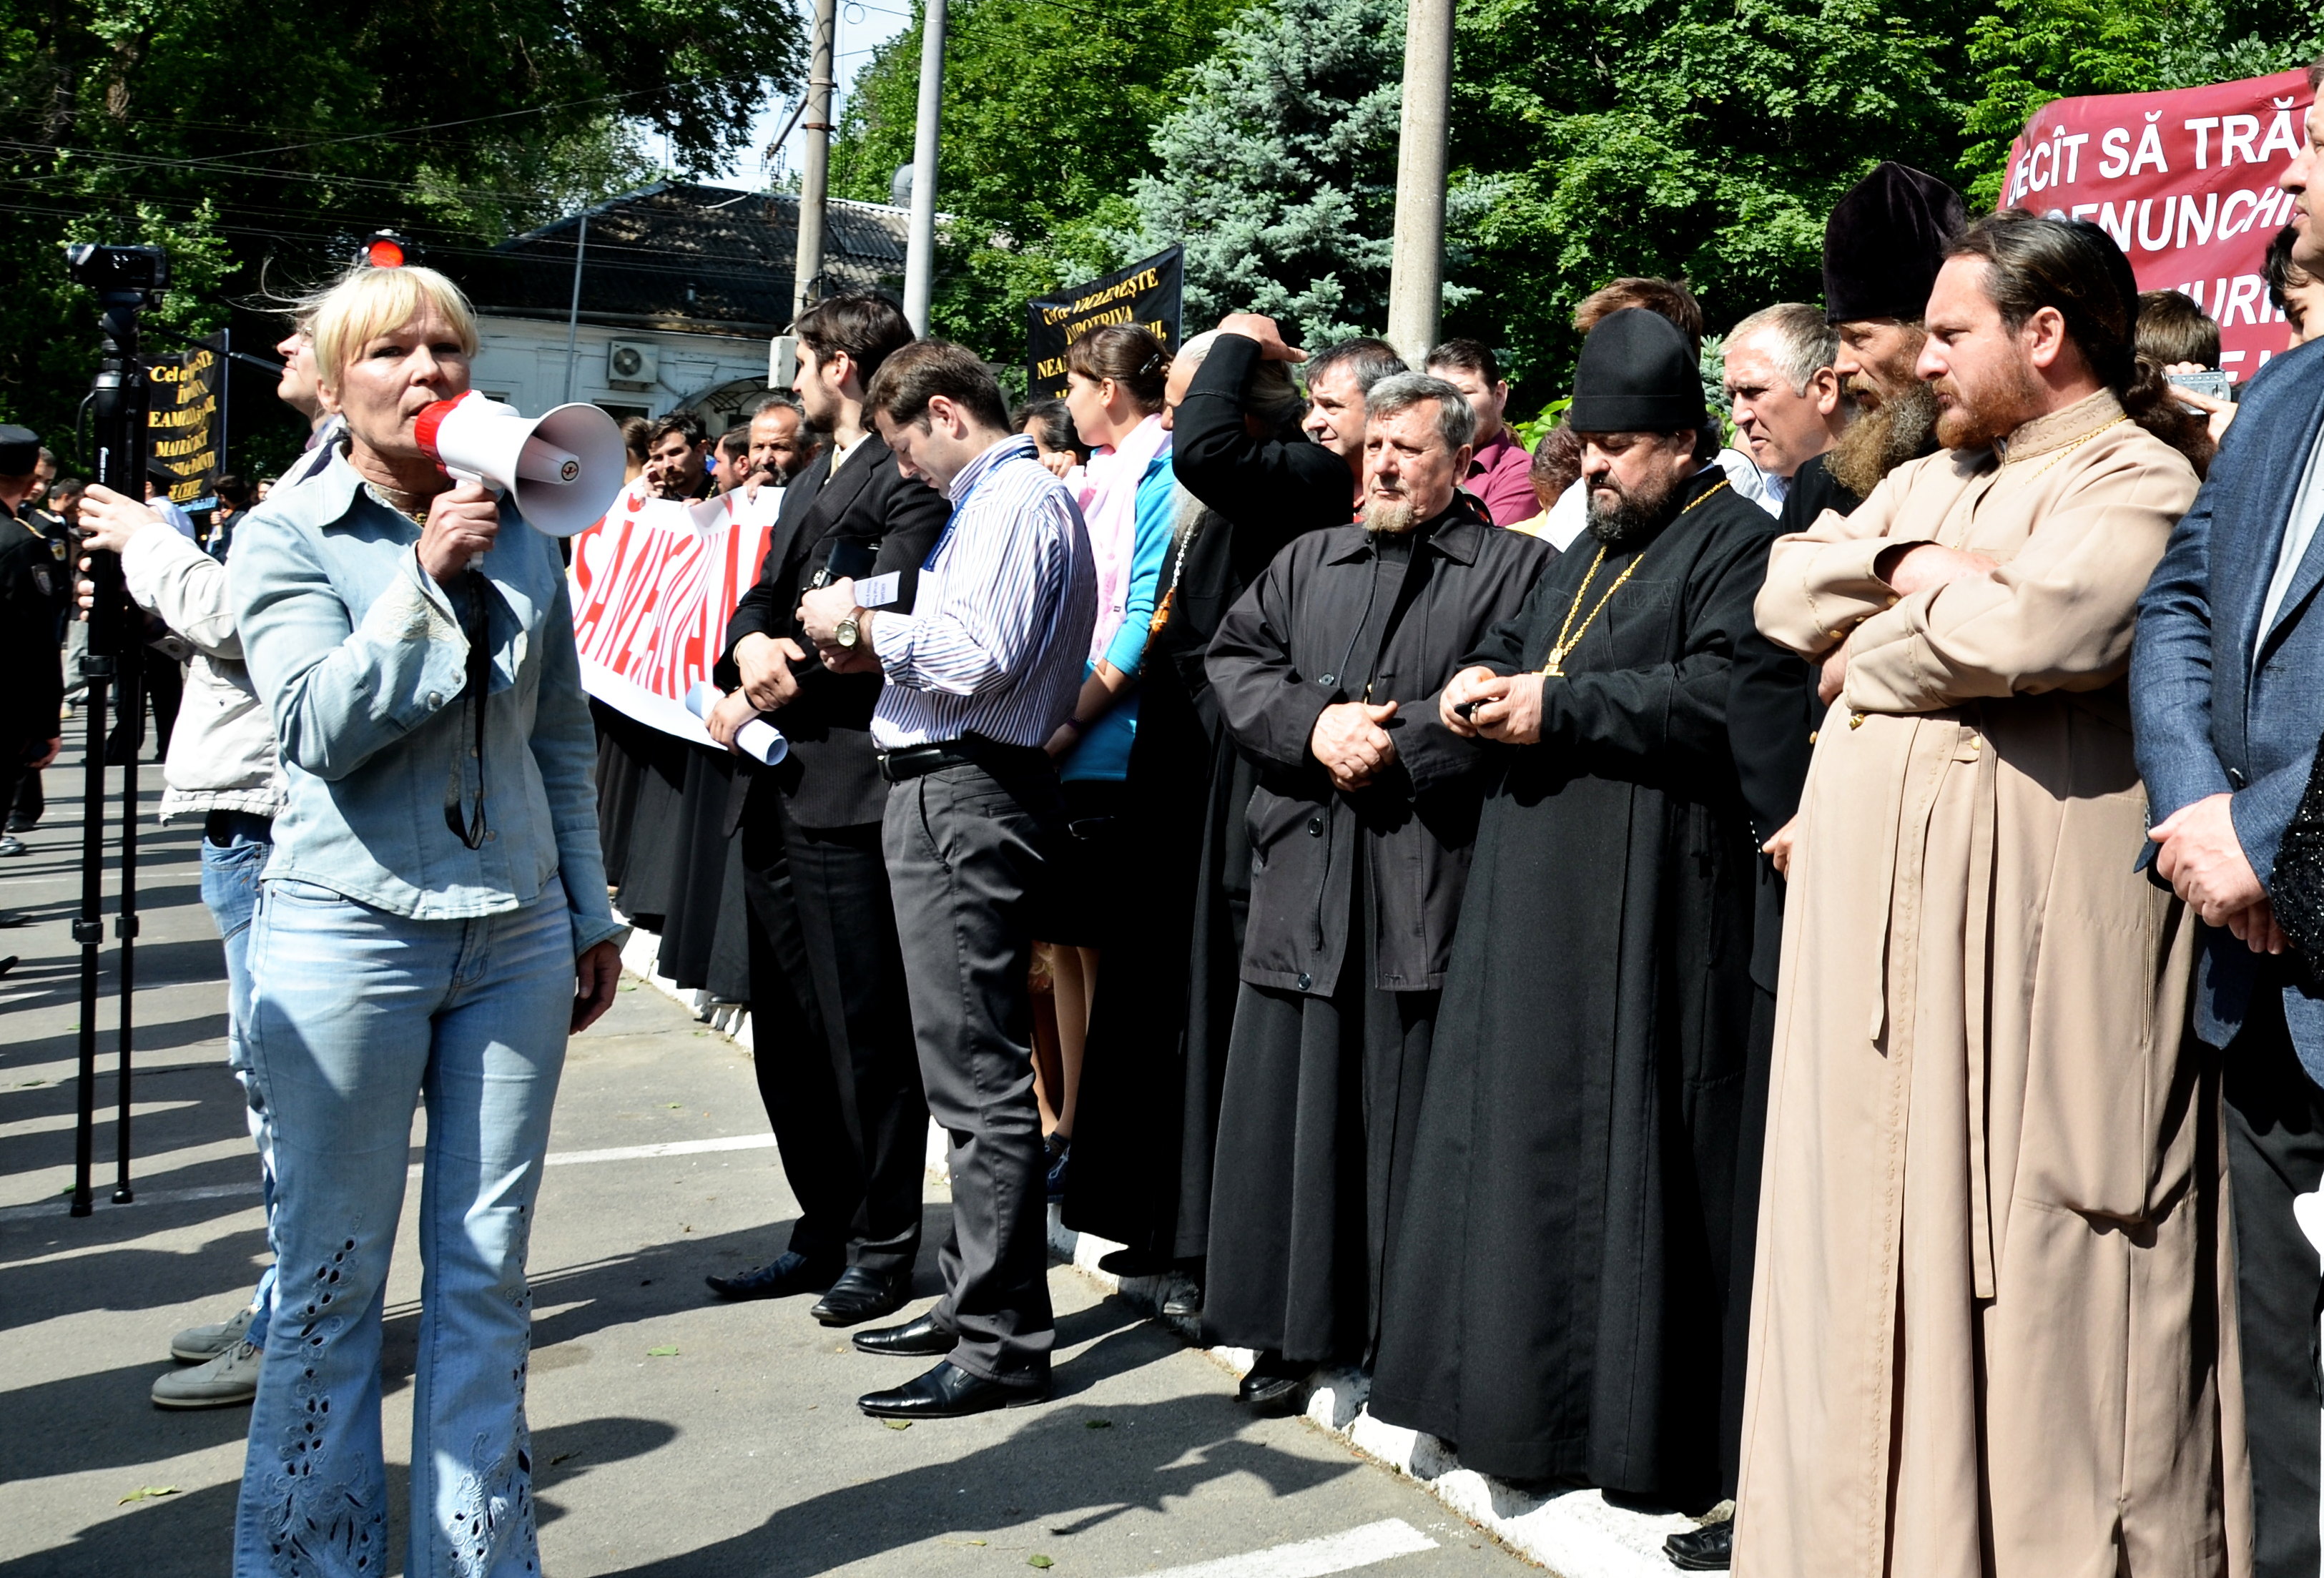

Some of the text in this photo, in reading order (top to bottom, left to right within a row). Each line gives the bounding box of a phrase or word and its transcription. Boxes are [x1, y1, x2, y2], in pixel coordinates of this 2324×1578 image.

[2007, 124, 2089, 207] DECÎT
[2099, 109, 2169, 179] SĂ
[2047, 184, 2296, 253] NUNCHI
